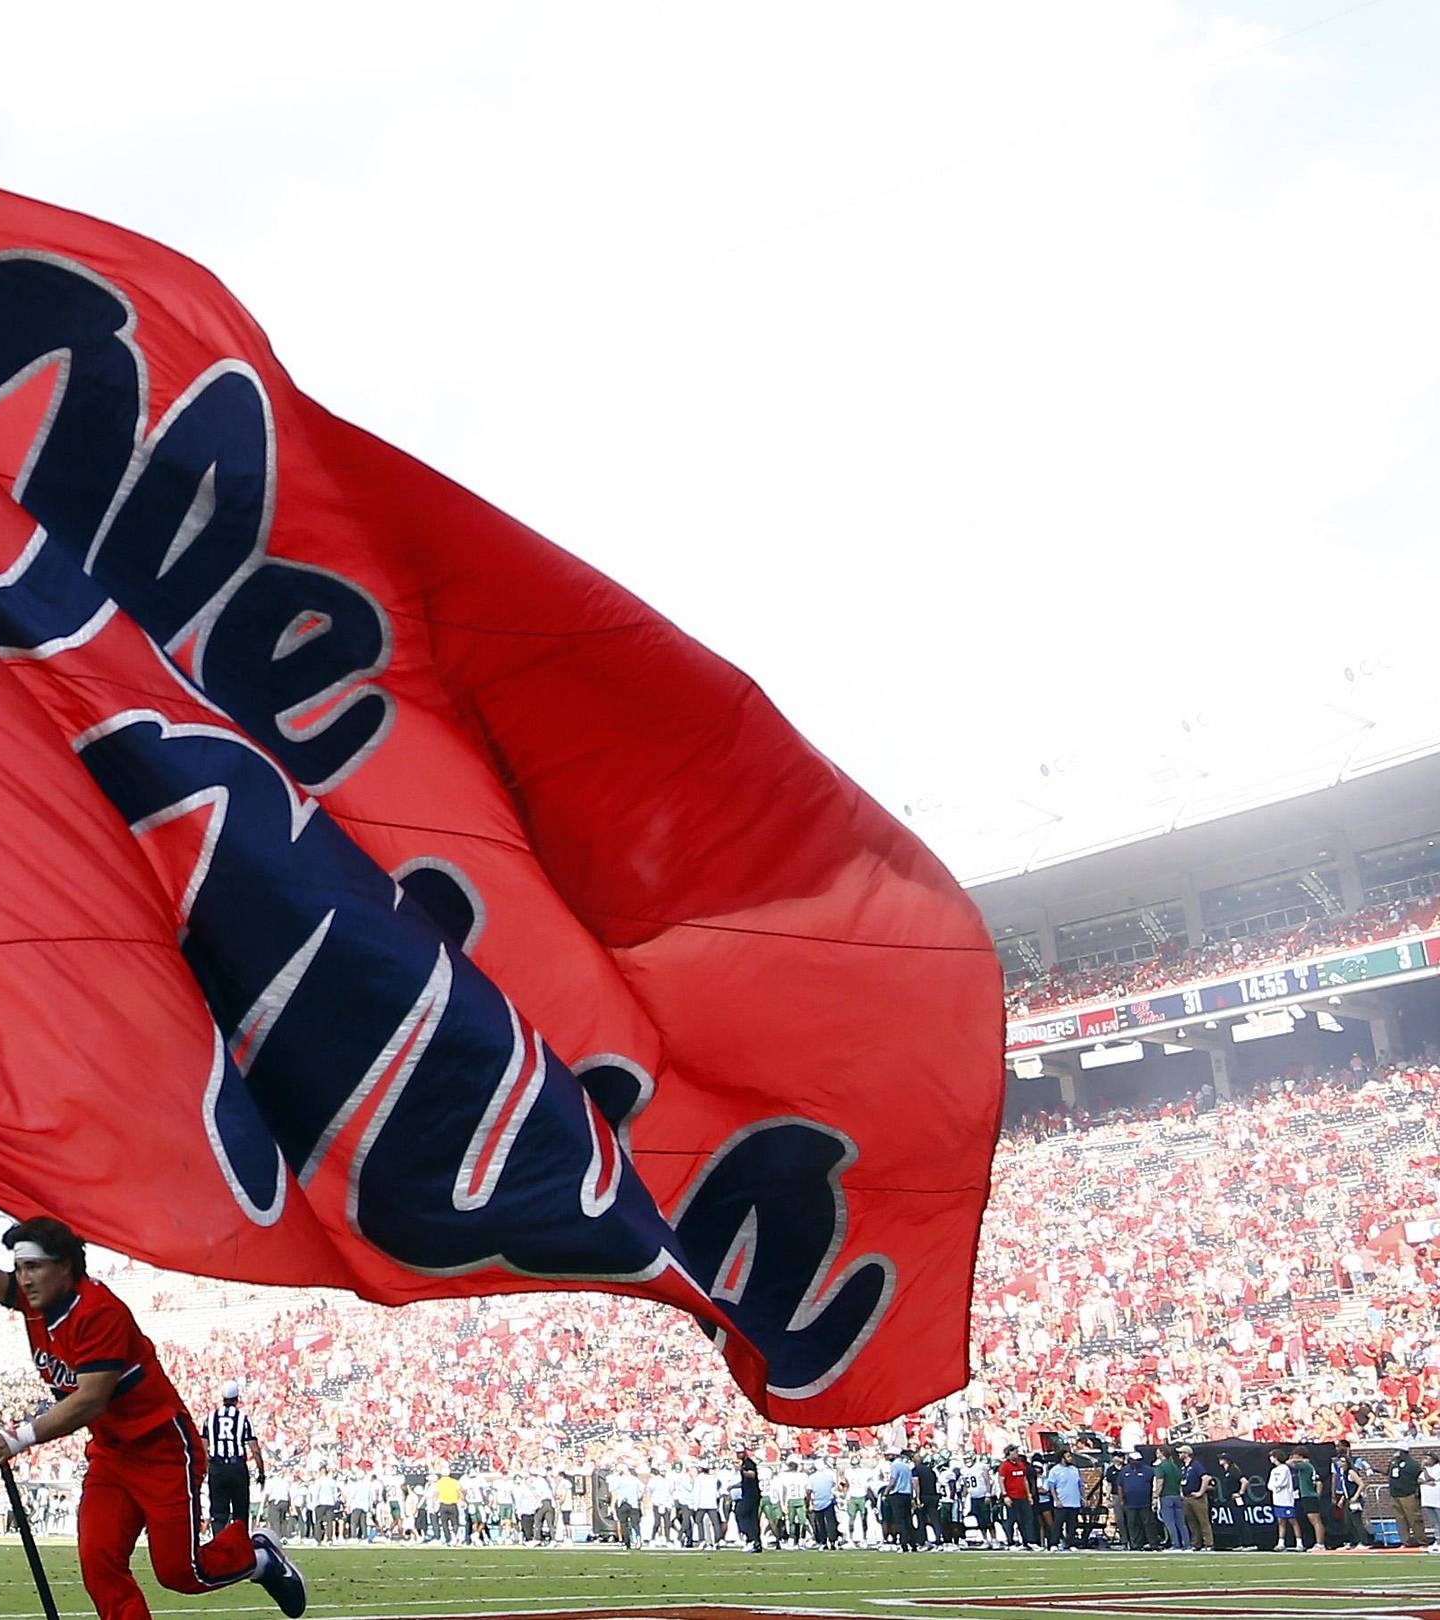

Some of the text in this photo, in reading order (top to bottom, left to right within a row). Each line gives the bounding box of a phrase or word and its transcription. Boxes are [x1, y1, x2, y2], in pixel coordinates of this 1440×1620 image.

[1396, 945, 1412, 970] 3
[1238, 970, 1288, 1003] 14:55
[1183, 990, 1203, 1015] 31
[1007, 1019, 1075, 1046] PONDERS
[218, 1416, 234, 1440] R
